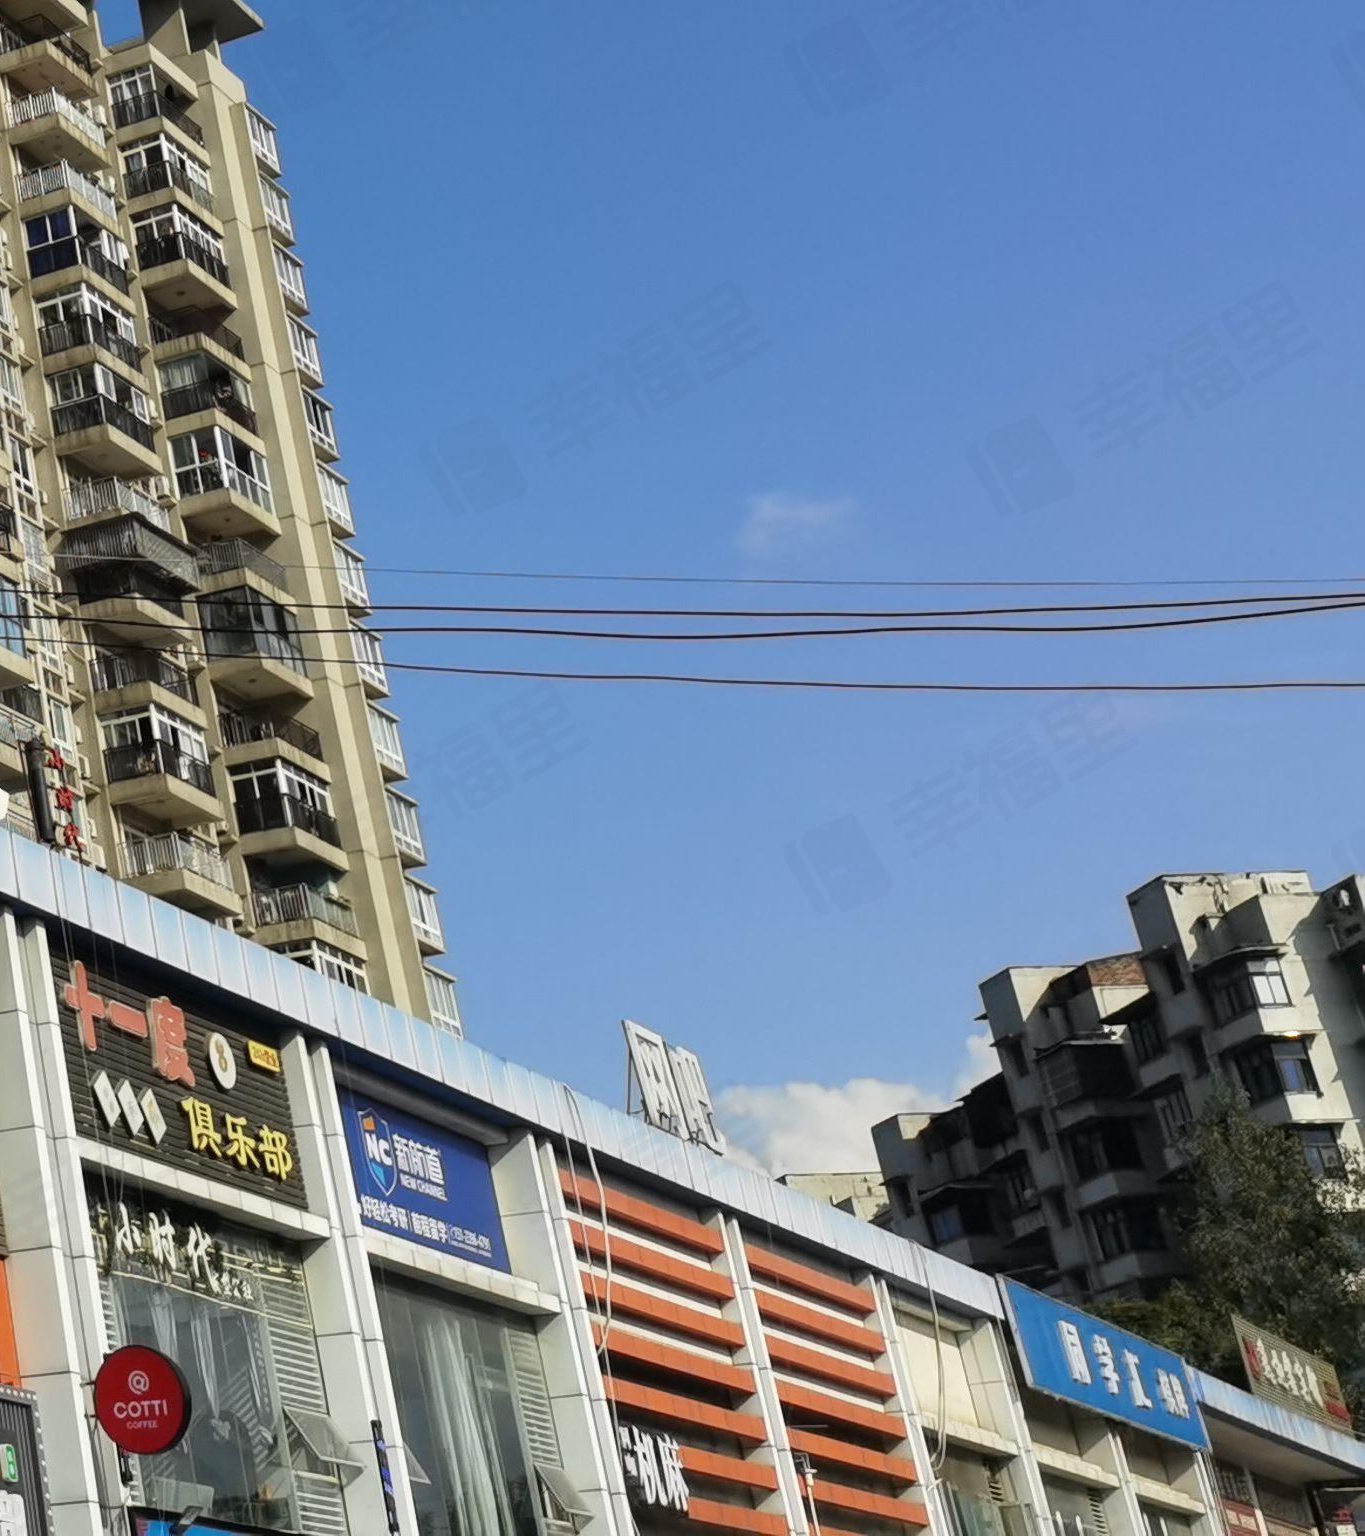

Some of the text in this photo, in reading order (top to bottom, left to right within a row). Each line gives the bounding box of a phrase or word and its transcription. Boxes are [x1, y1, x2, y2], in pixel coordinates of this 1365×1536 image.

[63, 960, 196, 1088] 十一度
[621, 1019, 728, 1156] 网吧
[181, 1095, 294, 1182] 俱乐部
[365, 1132, 394, 1167] NC
[391, 1132, 446, 1185] 新航道
[113, 1399, 168, 1419] COTTI
[126, 1419, 158, 1430] COFFEE
